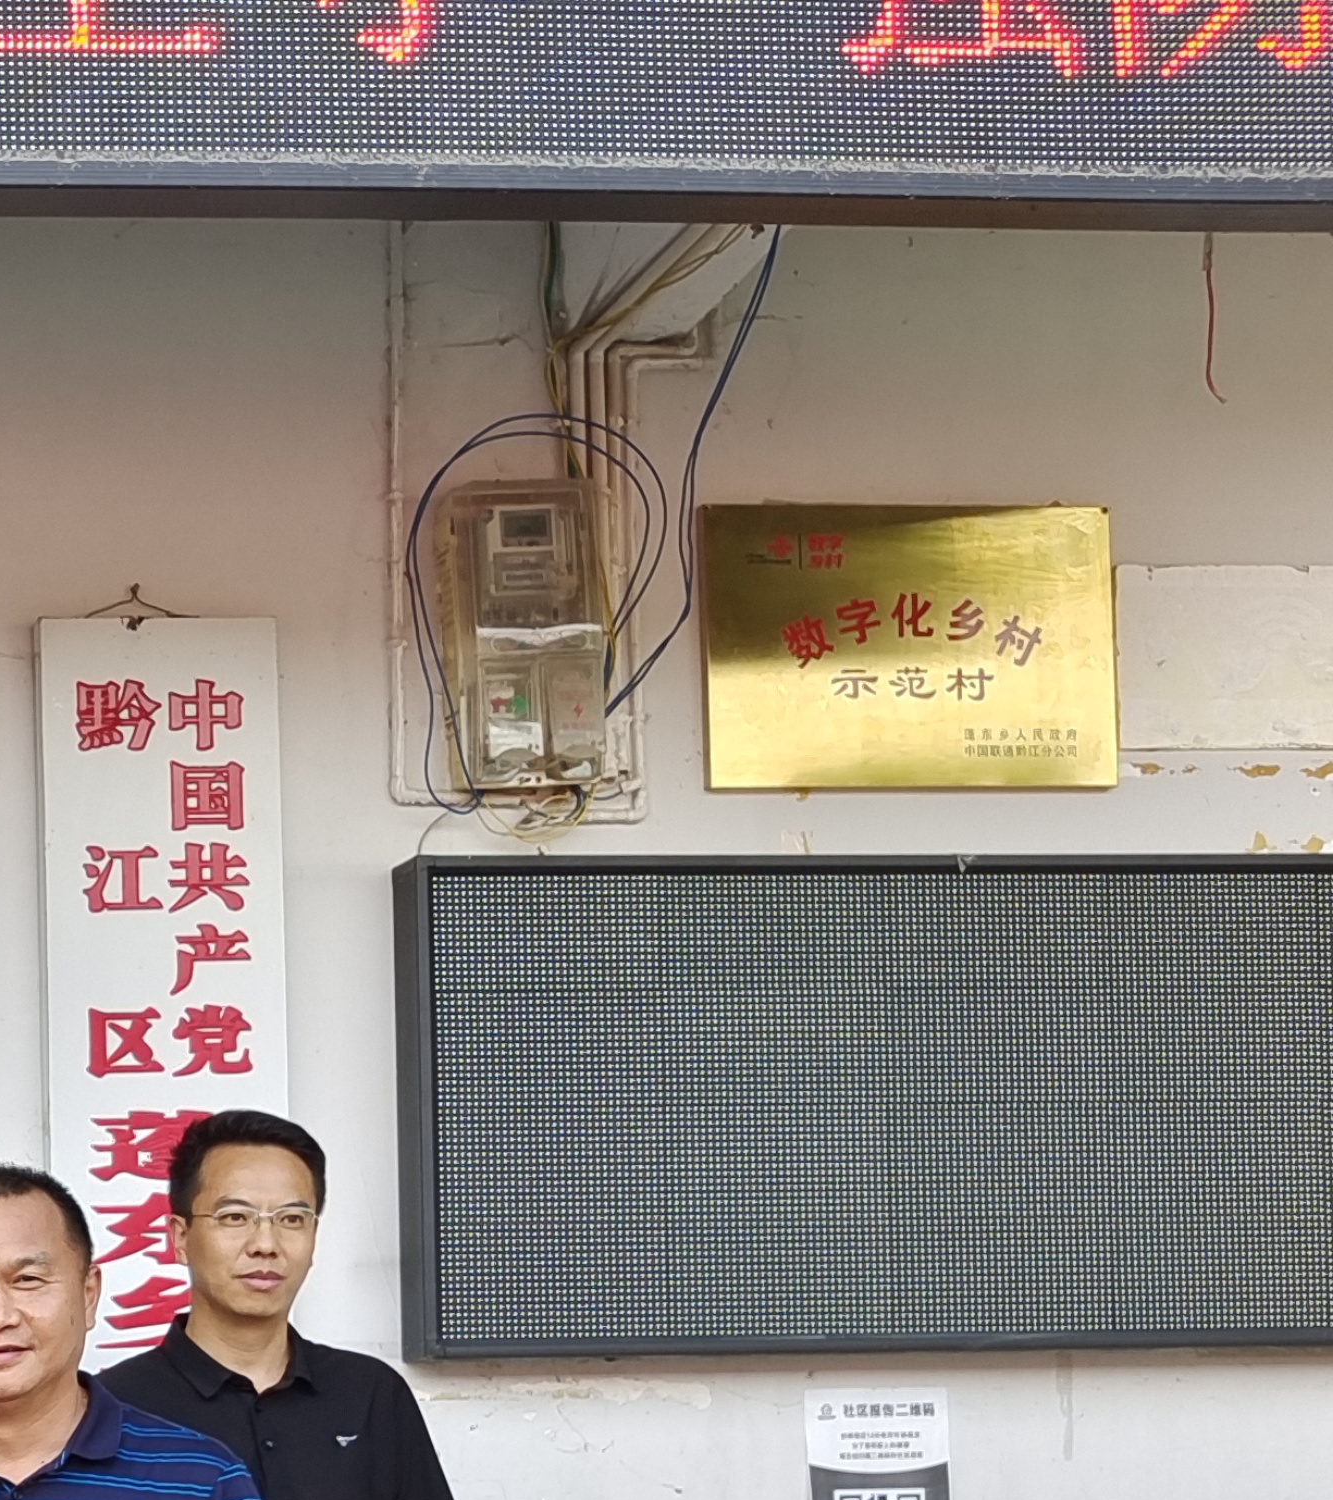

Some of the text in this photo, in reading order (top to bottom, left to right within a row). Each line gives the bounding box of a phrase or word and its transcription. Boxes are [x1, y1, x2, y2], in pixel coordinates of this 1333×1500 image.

[782, 593, 1042, 669] 数字化乡村
[831, 667, 994, 700] 示范村
[75, 679, 165, 1078] 黔江区
[168, 678, 253, 1077] 中国共产党
[89, 1110, 214, 1372] 蓬东乡
